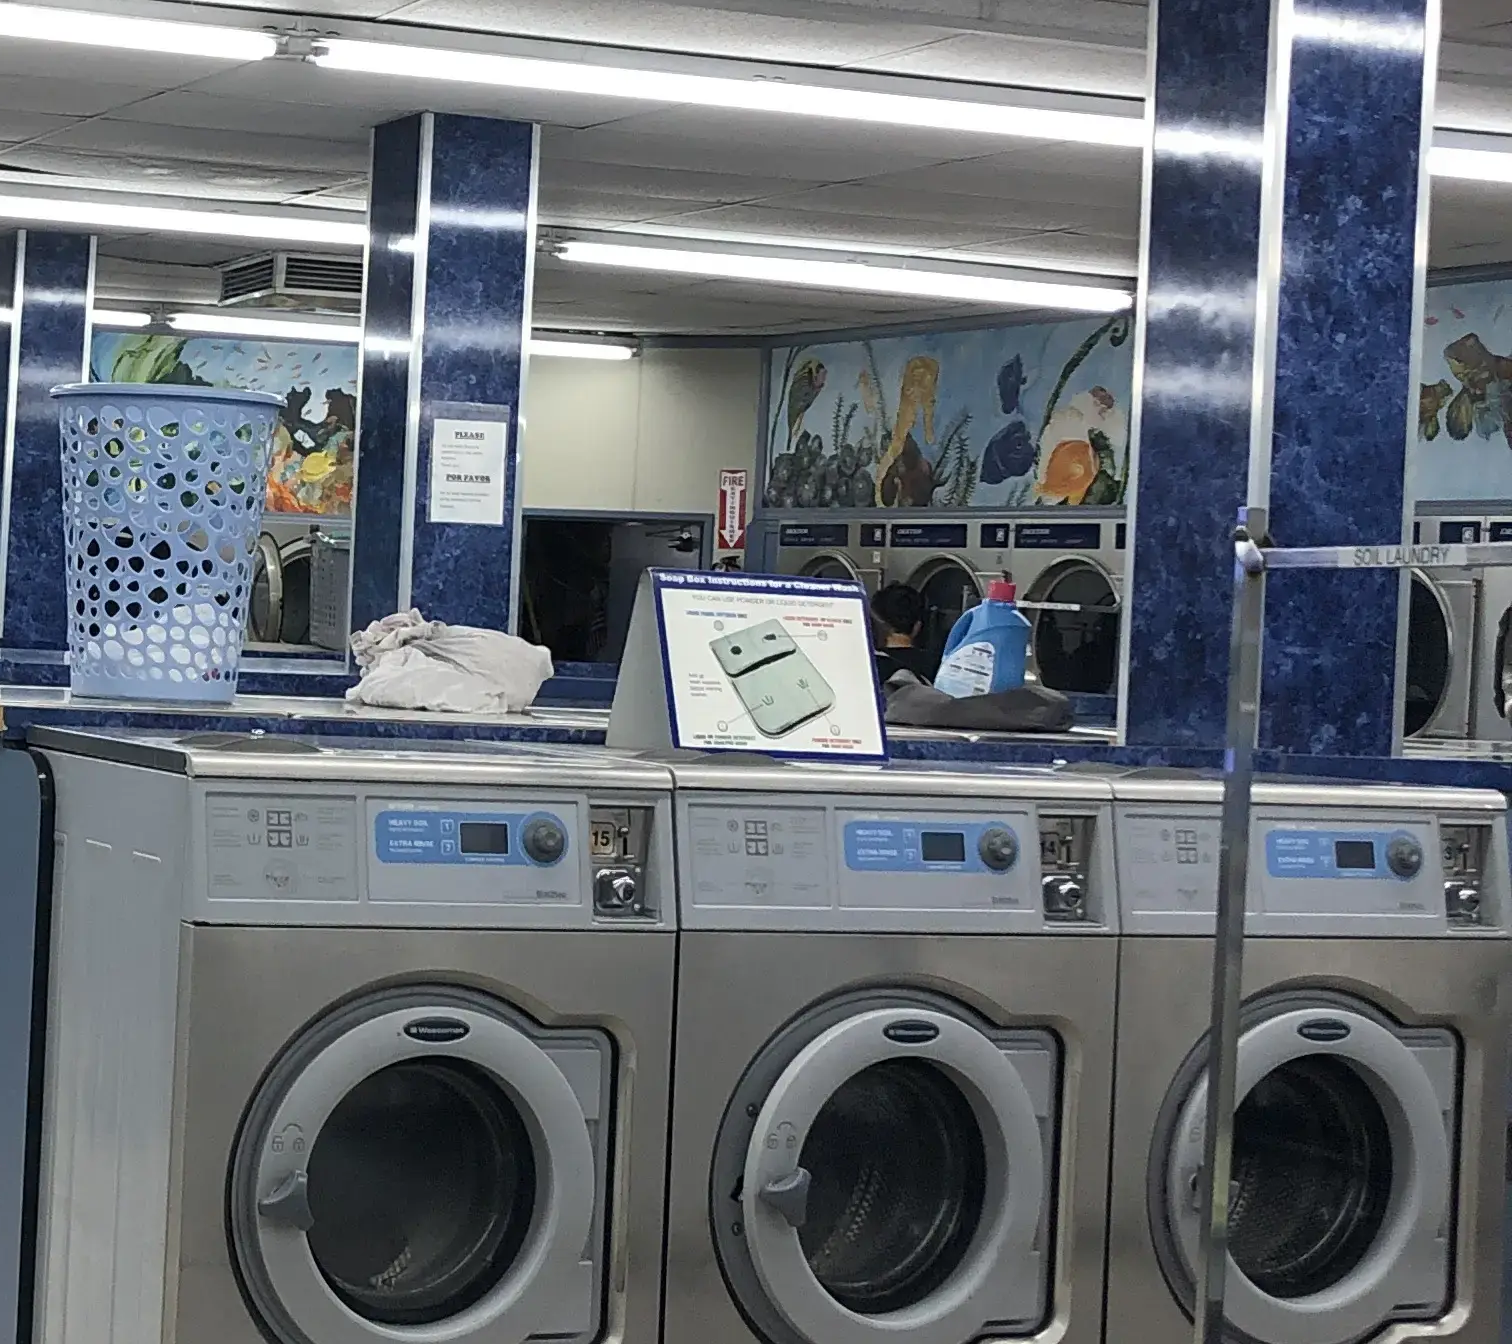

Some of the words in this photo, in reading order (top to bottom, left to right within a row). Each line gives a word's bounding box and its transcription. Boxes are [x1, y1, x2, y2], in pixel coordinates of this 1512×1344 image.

[454, 431, 485, 440] PLEASE
[446, 474, 462, 482] POR
[463, 475, 491, 483] FAVOR
[722, 475, 744, 487] FIRE
[1386, 546, 1450, 565] LAUNDRY
[659, 573, 685, 584] Soap
[686, 574, 707, 584] Box
[707, 576, 767, 587] Instructions
[768, 579, 784, 588] for
[793, 581, 831, 591] Cleaner
[592, 830, 610, 847] 15
